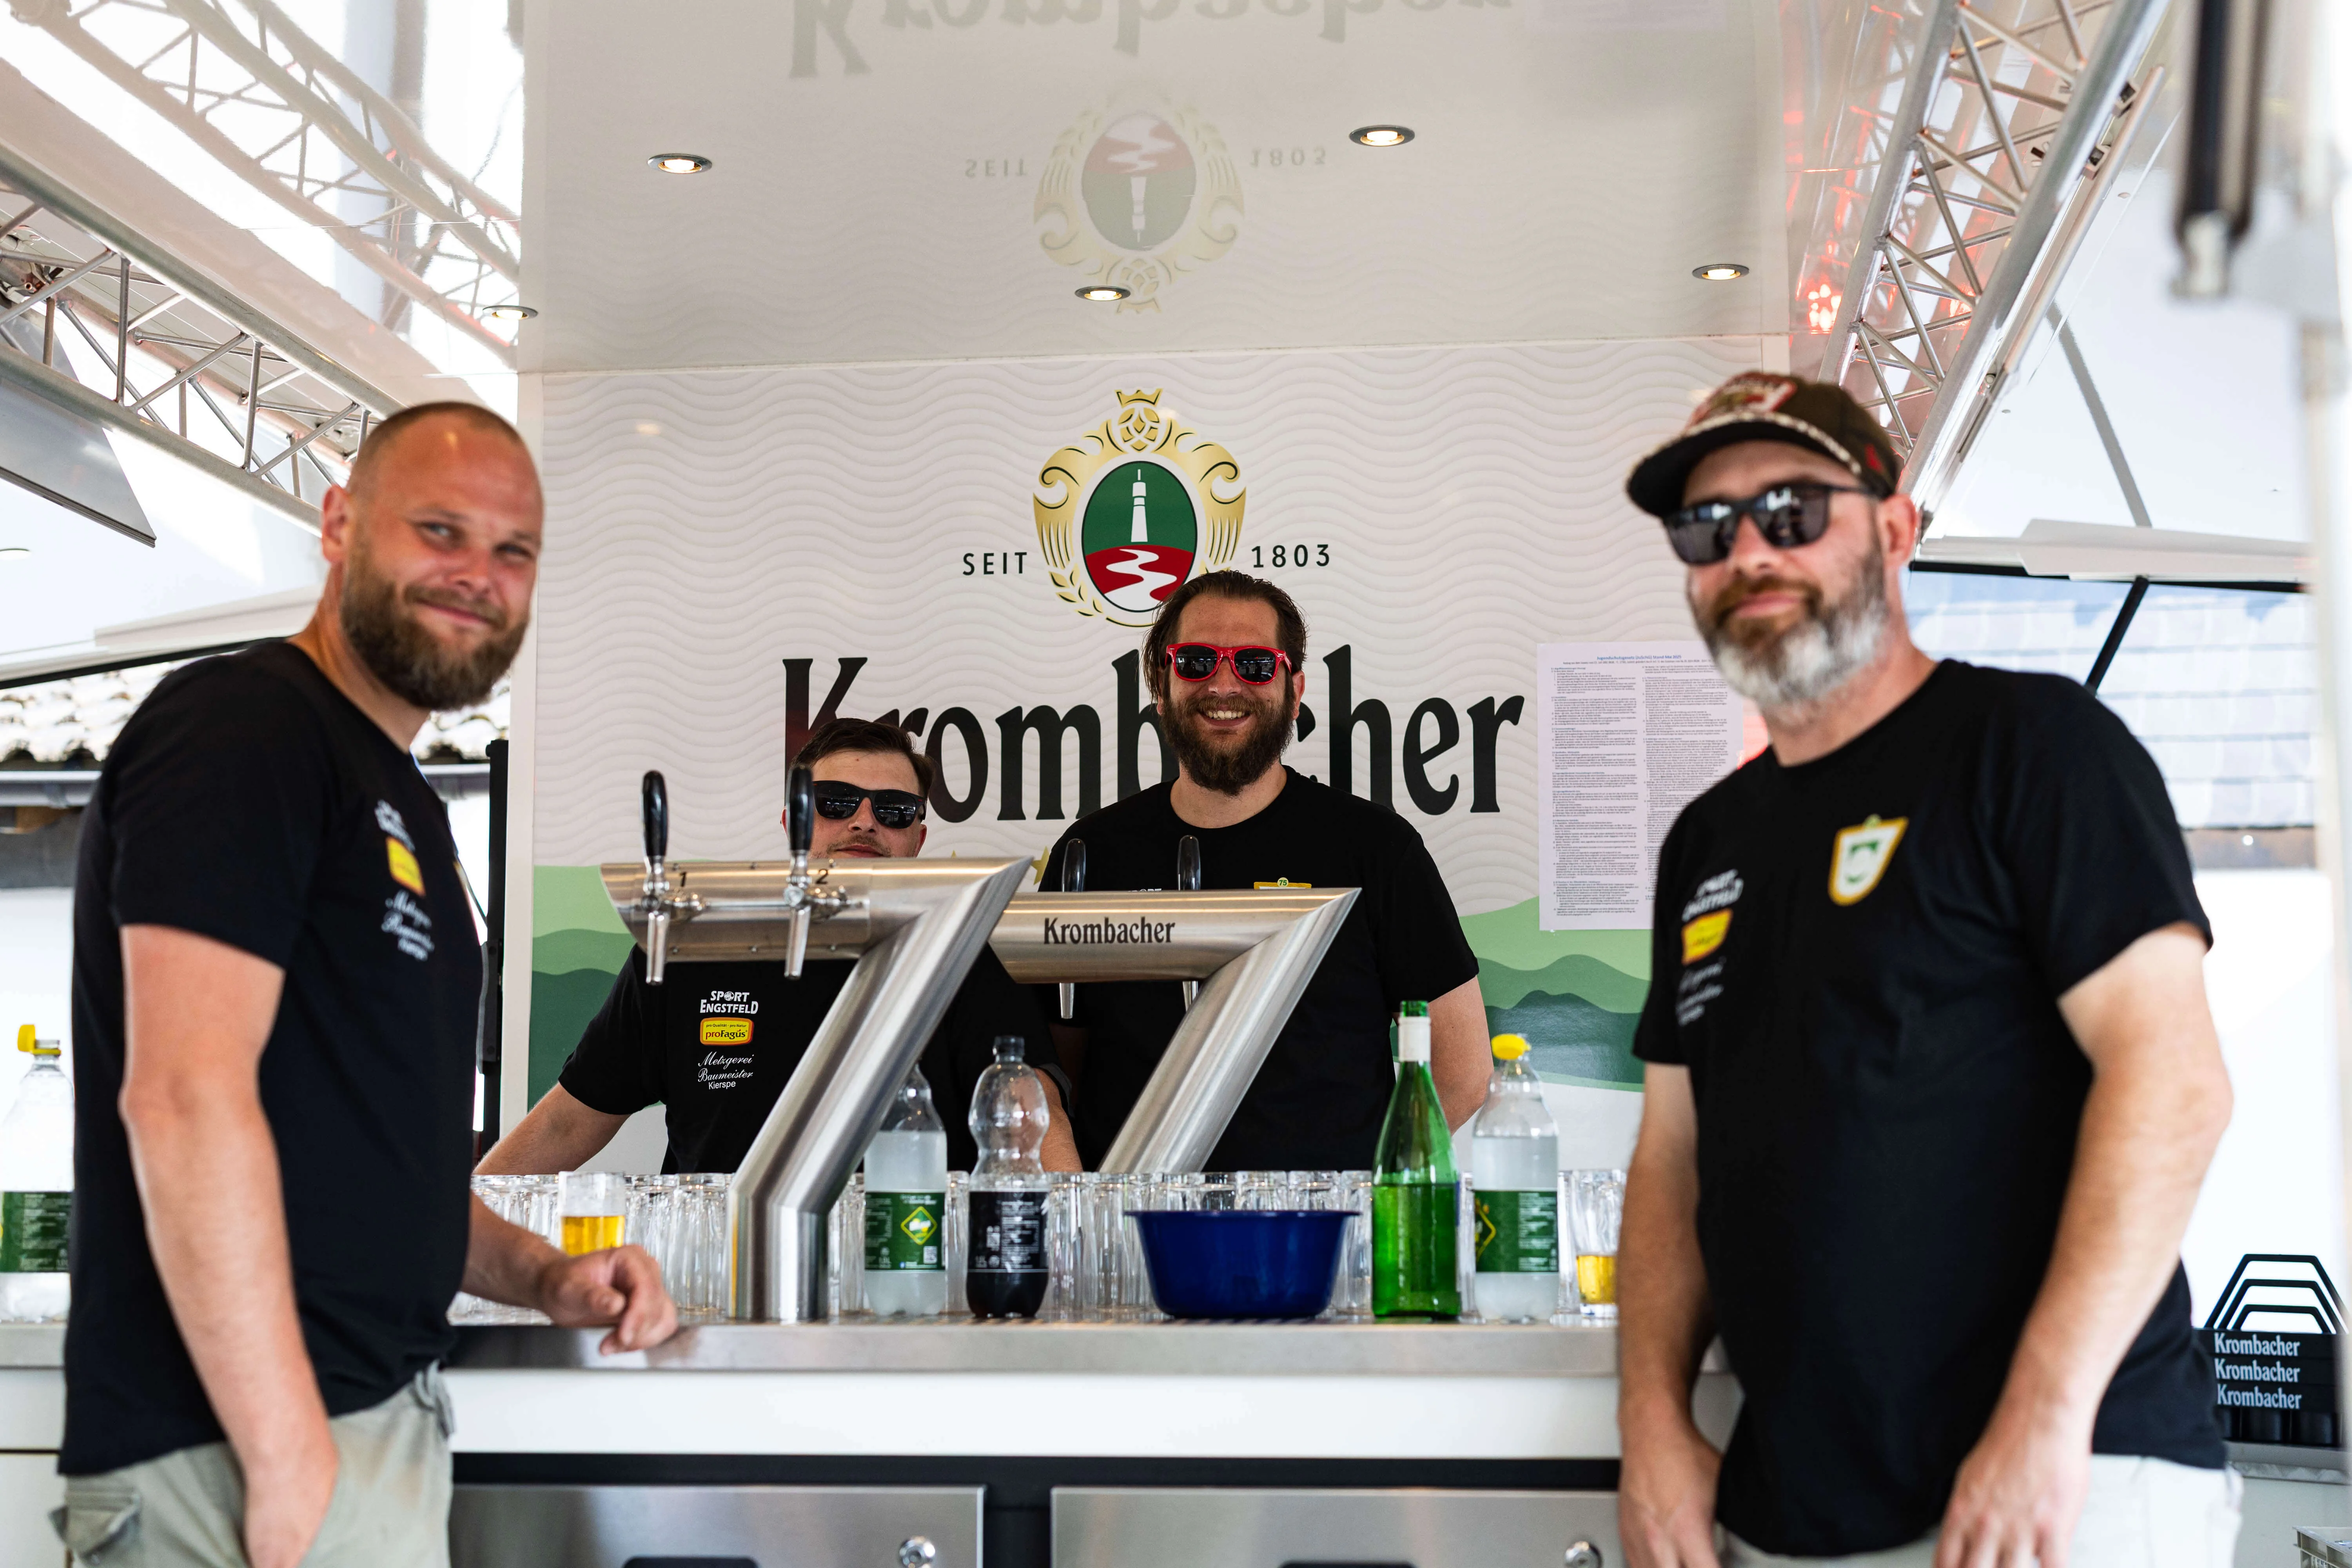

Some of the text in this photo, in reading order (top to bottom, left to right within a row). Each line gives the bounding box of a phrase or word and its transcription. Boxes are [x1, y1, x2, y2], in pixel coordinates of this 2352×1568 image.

[962, 543, 1332, 576] SEIT 1803
[679, 871, 688, 887] 1
[815, 868, 829, 885] 2
[1044, 916, 1176, 945] Krombacher
[698, 1051, 755, 1069] Metzgerei
[698, 1068, 753, 1082] Baumeister
[708, 1081, 736, 1090] Kierspe
[2214, 1332, 2300, 1356] Krombacher
[2215, 1358, 2300, 1382] Krombacher
[2217, 1383, 2302, 1409] Krombacher
